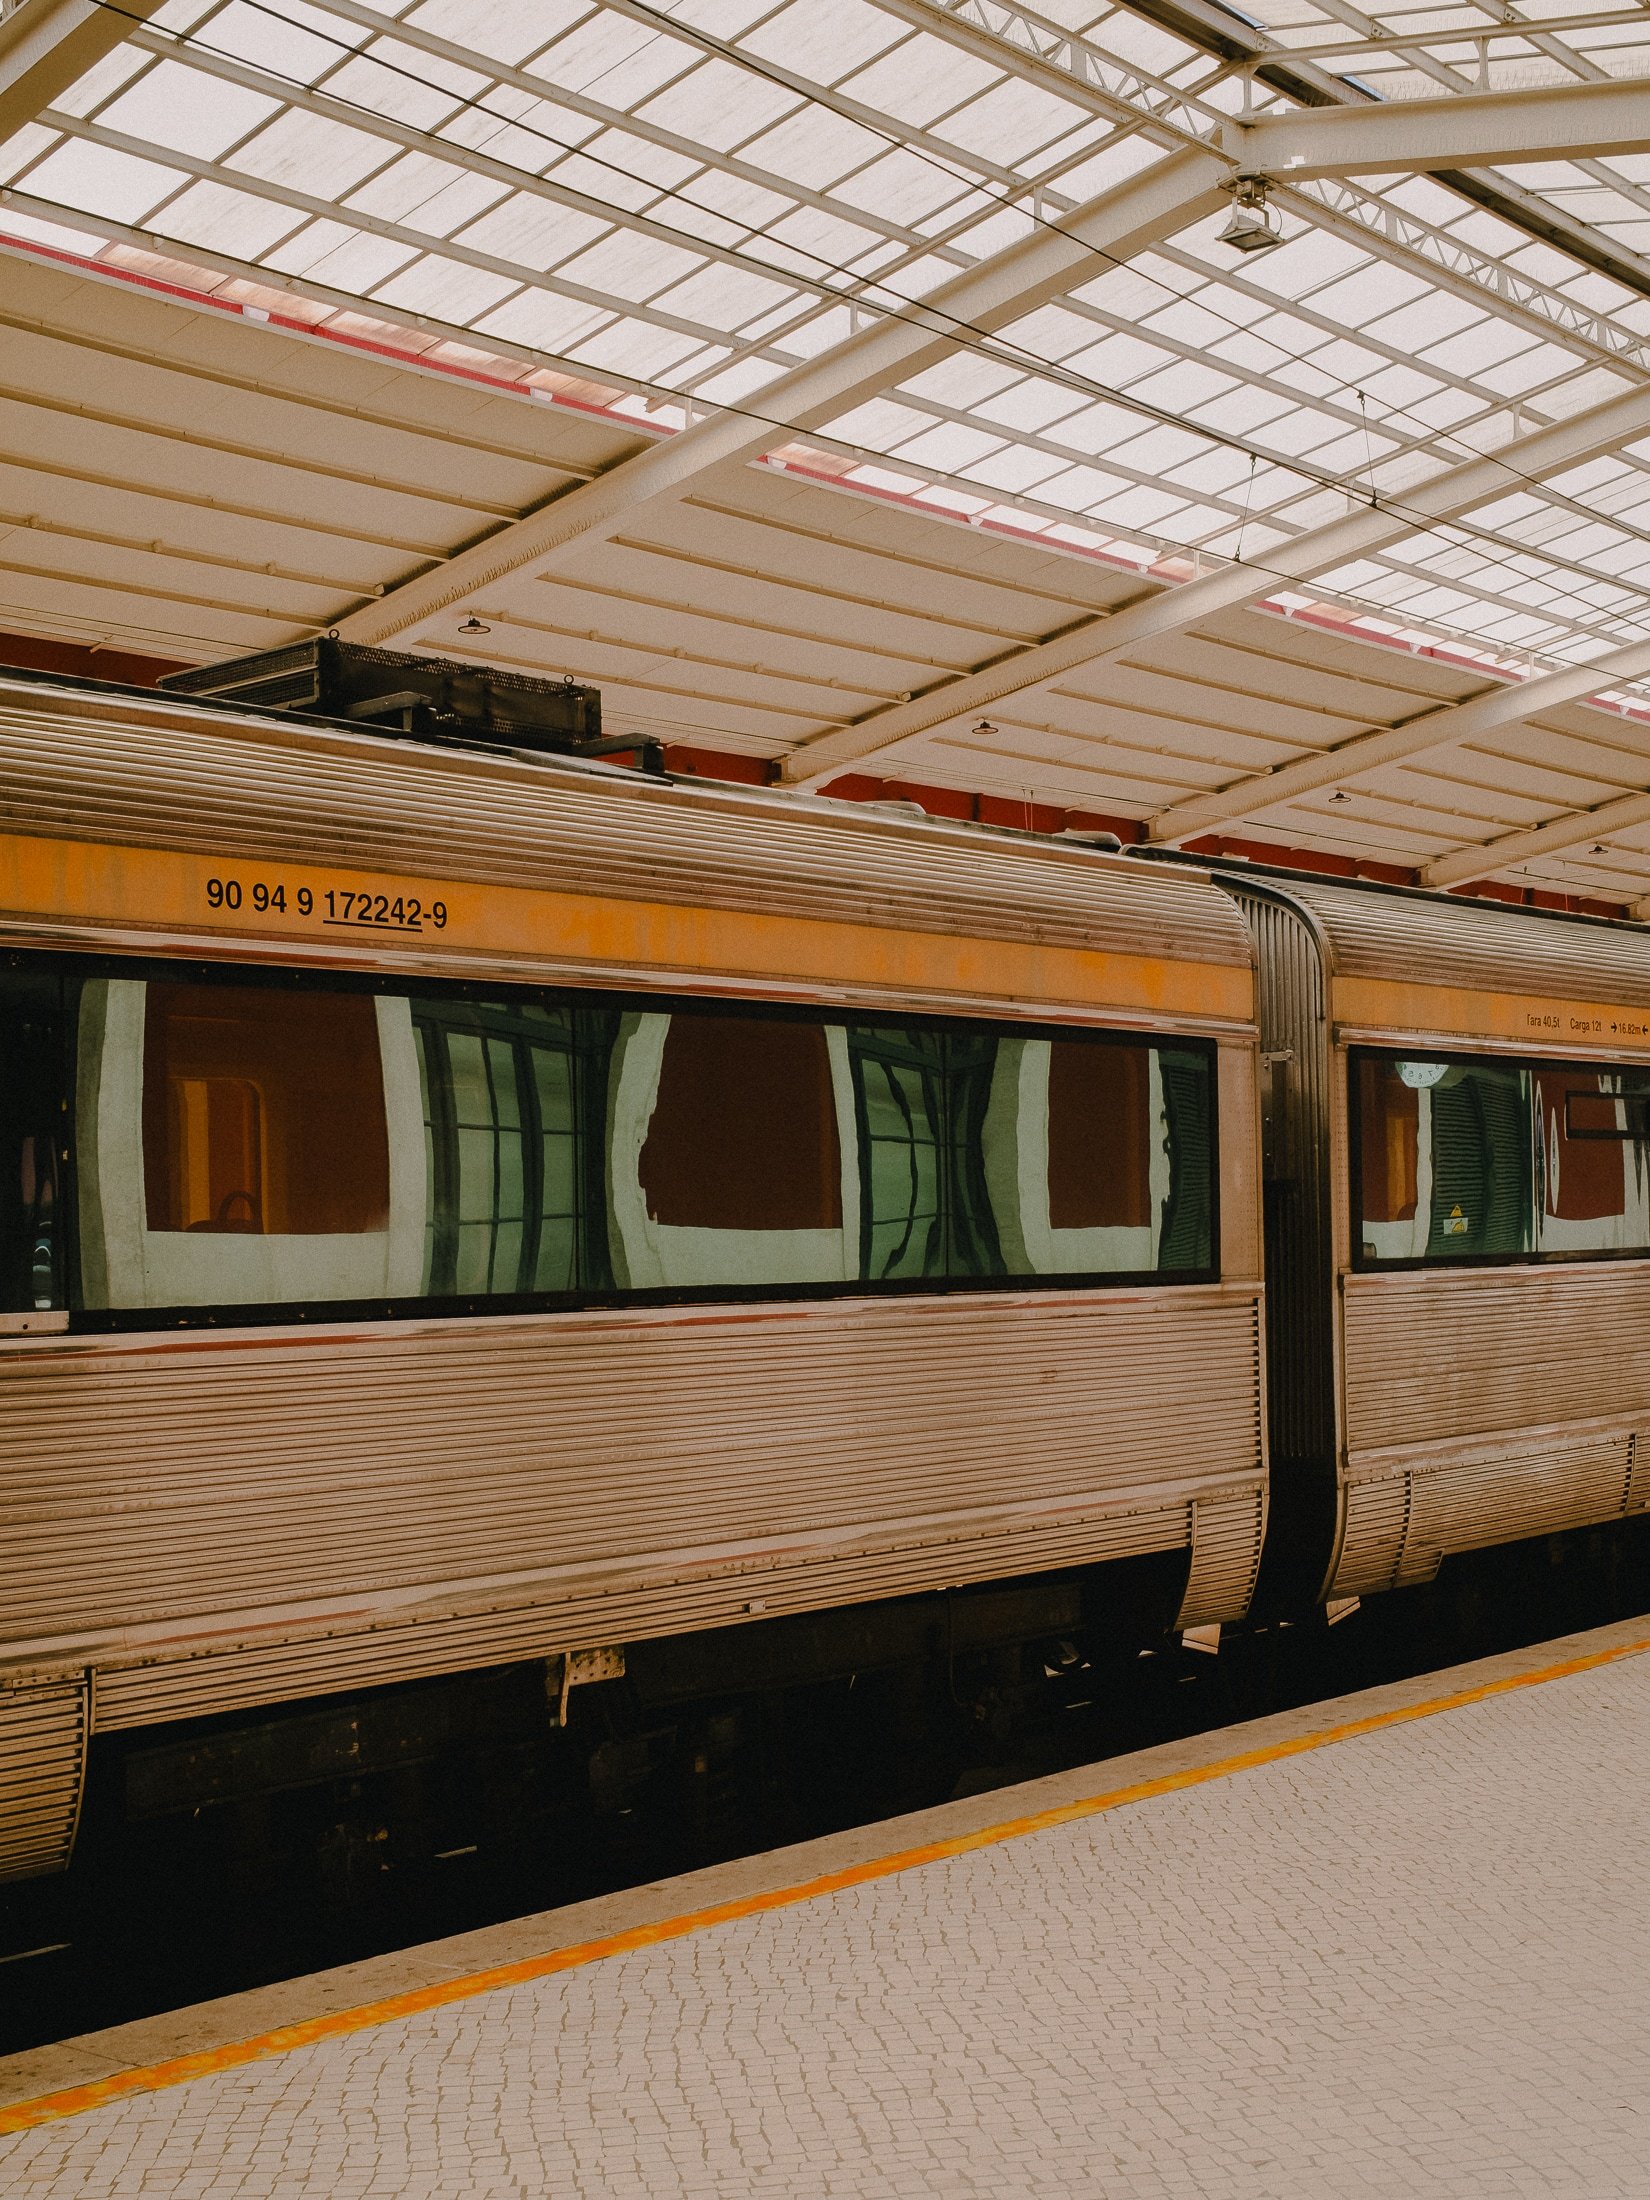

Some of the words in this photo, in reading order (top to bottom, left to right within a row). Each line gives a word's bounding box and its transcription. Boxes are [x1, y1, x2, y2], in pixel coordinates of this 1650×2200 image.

[206, 878, 243, 910] 90
[252, 882, 288, 913] 94
[296, 887, 314, 916] 9
[324, 890, 447, 929] 172242-9
[1526, 1013, 1542, 1027] Tara
[1570, 1018, 1590, 1033] Carga
[1591, 1020, 1602, 1032] 12t
